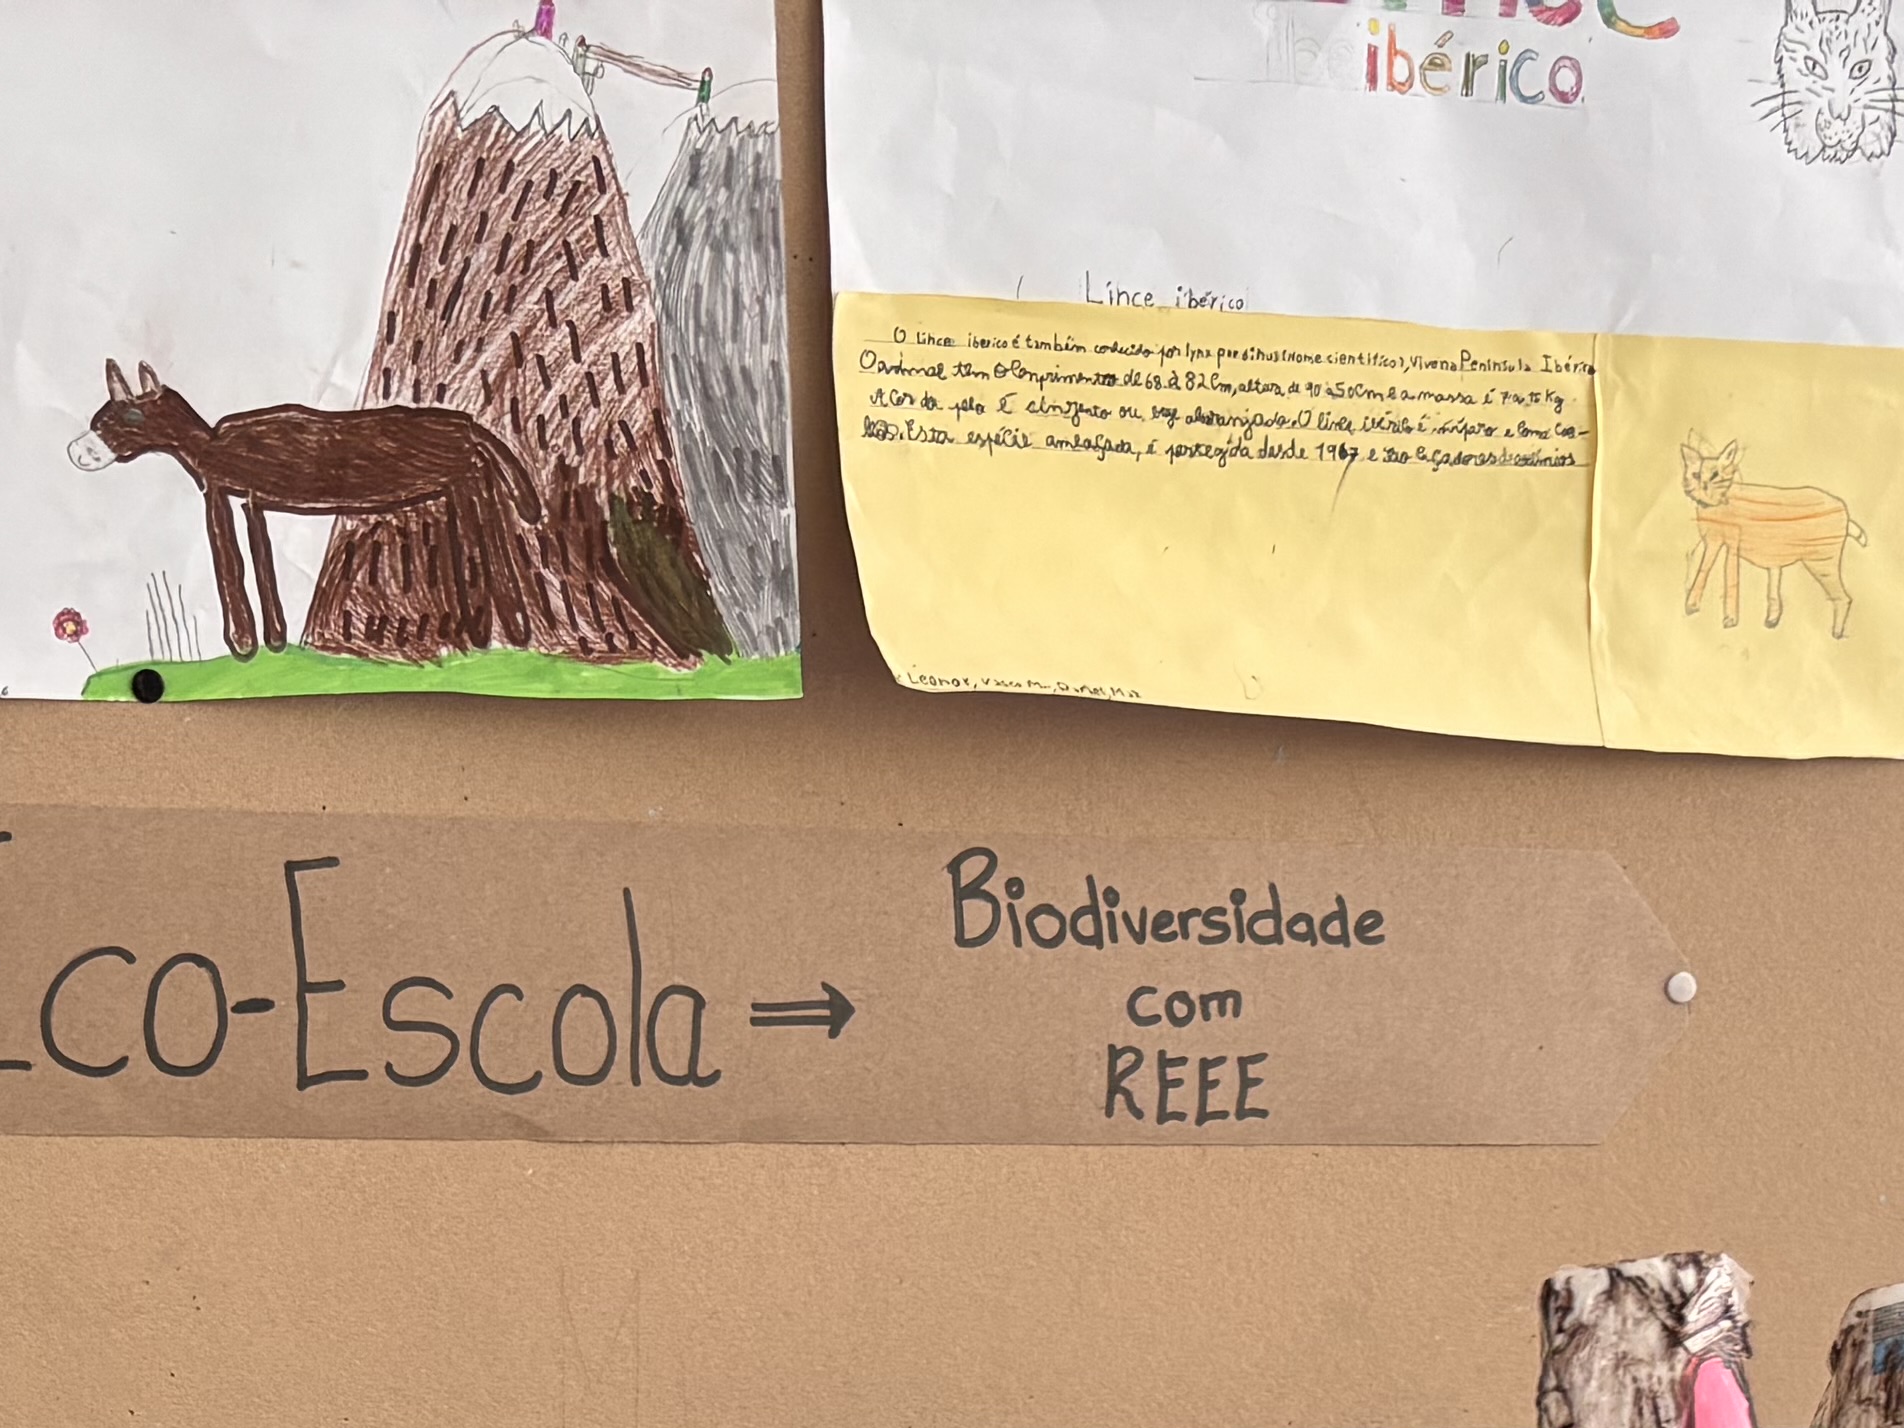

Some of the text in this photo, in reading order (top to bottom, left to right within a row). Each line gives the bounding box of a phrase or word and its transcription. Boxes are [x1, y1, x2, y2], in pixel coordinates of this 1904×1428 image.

[1364, 18, 1585, 106] ibérico
[1086, 270, 1244, 312] Lince ibérico
[893, 327, 906, 343] O
[1013, 334, 1020, 349] é
[1158, 345, 1181, 367] por
[860, 349, 876, 370] O
[1146, 373, 1161, 390] 68
[1185, 371, 1209, 391] 82
[1298, 410, 1311, 427] O
[1368, 448, 1378, 462] e
[943, 846, 1386, 950] Biodiversidade
[1127, 985, 1242, 1028] com
[1105, 1044, 1270, 1127] REEE
